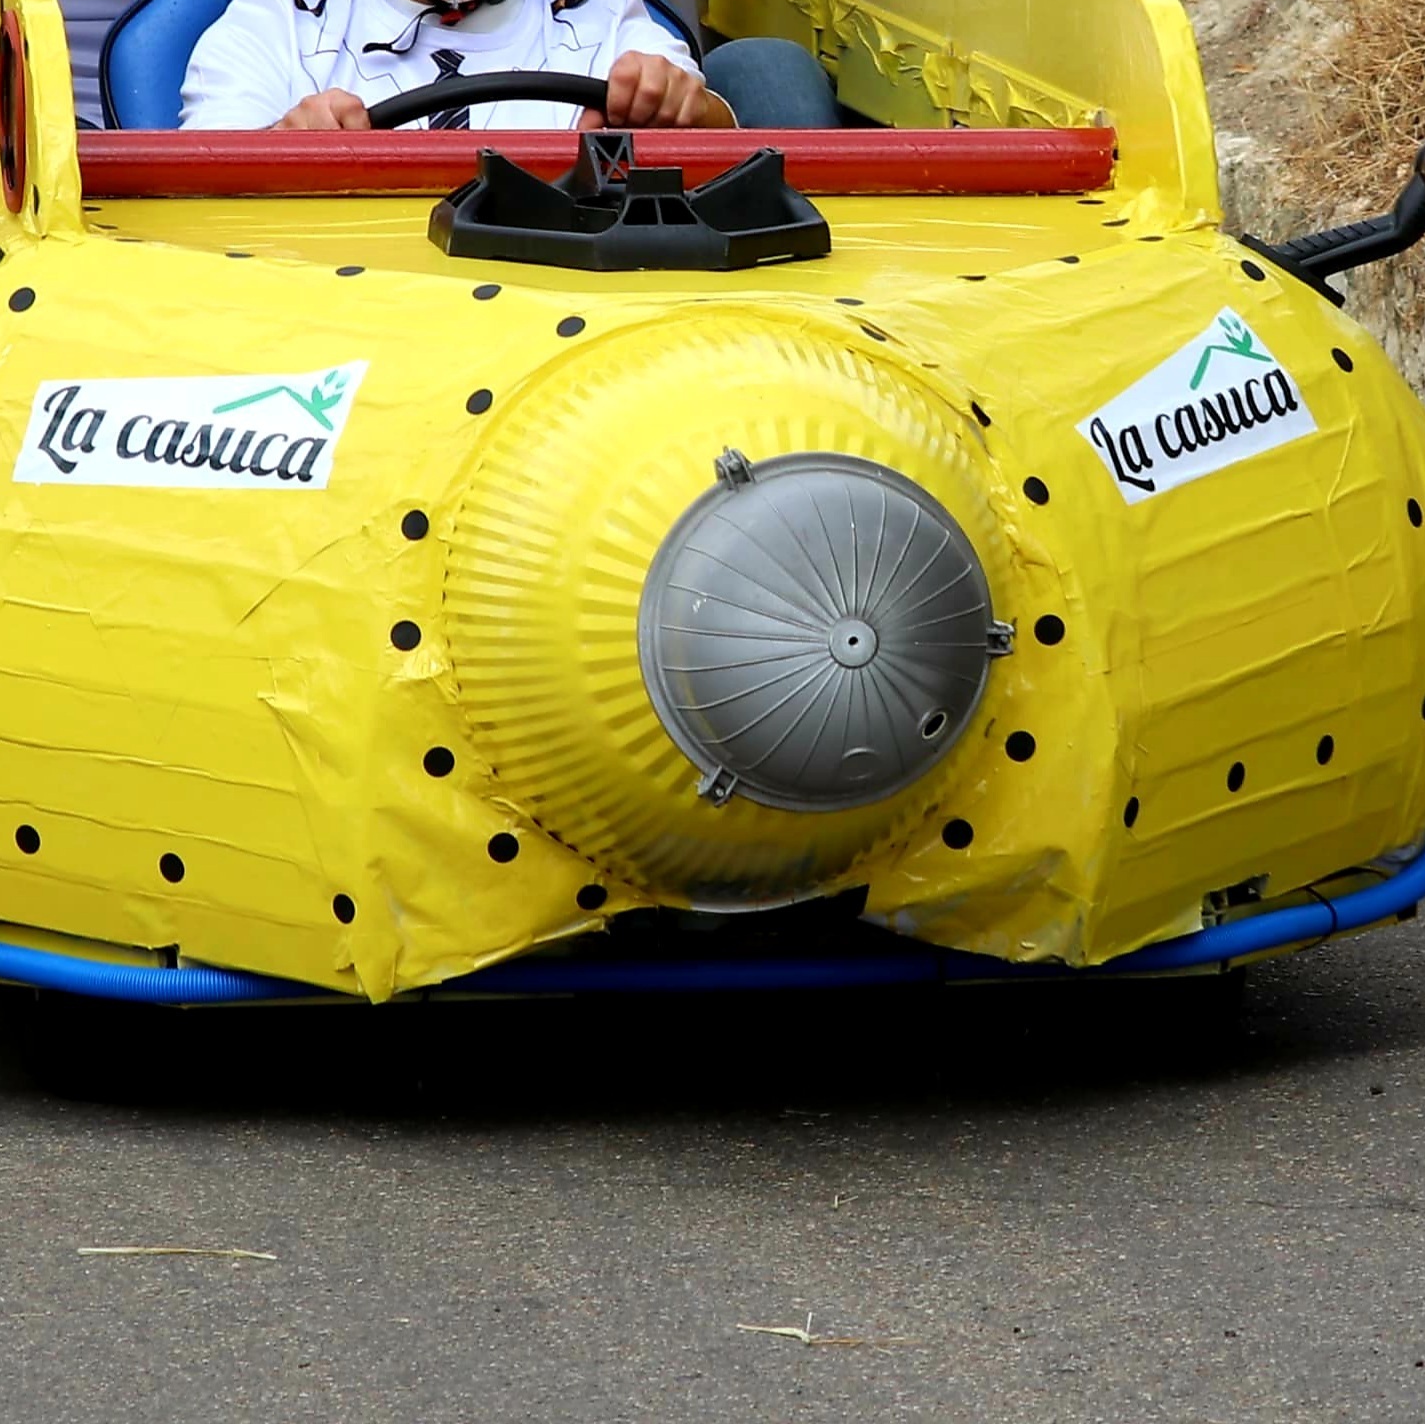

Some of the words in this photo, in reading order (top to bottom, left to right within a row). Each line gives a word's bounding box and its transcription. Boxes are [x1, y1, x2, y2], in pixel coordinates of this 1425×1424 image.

[37, 385, 107, 474] La
[115, 413, 328, 482] casuca
[1089, 417, 1156, 493] La
[1154, 368, 1298, 459] casuca
